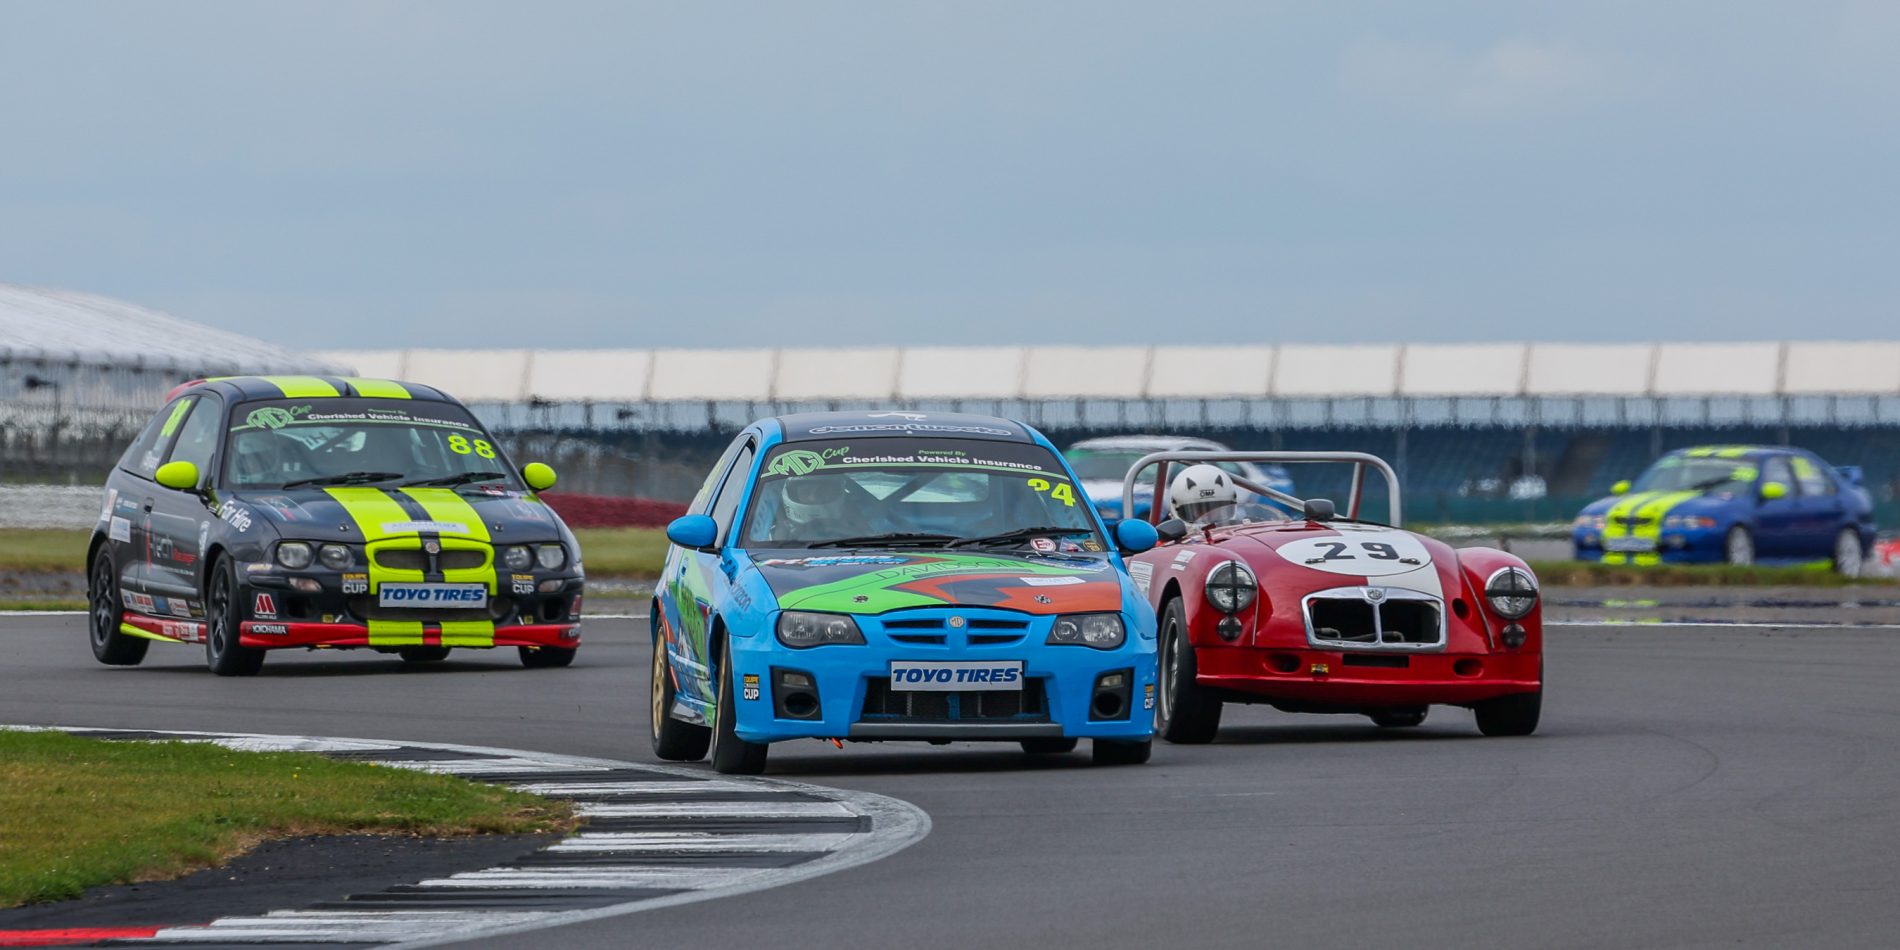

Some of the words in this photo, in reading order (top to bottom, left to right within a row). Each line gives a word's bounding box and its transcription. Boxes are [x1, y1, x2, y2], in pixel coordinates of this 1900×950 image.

[367, 413, 411, 421] Vehicle
[413, 416, 469, 428] Insurance
[448, 435, 496, 459] 88
[768, 450, 825, 475] MG
[822, 446, 850, 459] Cup
[842, 456, 914, 464] Cherished
[917, 456, 970, 464] Vehicle
[973, 457, 1042, 471] Insurance
[218, 500, 236, 520] For
[228, 508, 252, 533] Hire
[1314, 542, 1400, 560] 29
[875, 561, 1025, 580] DAVIDSON
[342, 583, 368, 594] CUP
[382, 588, 434, 601] TOYO
[434, 588, 485, 601] TIRES
[512, 584, 535, 594] CUP
[252, 624, 287, 634] YOKOHAMA
[893, 668, 953, 683] TOYO
[956, 668, 1020, 683] TIRES
[744, 688, 759, 700] CUP
